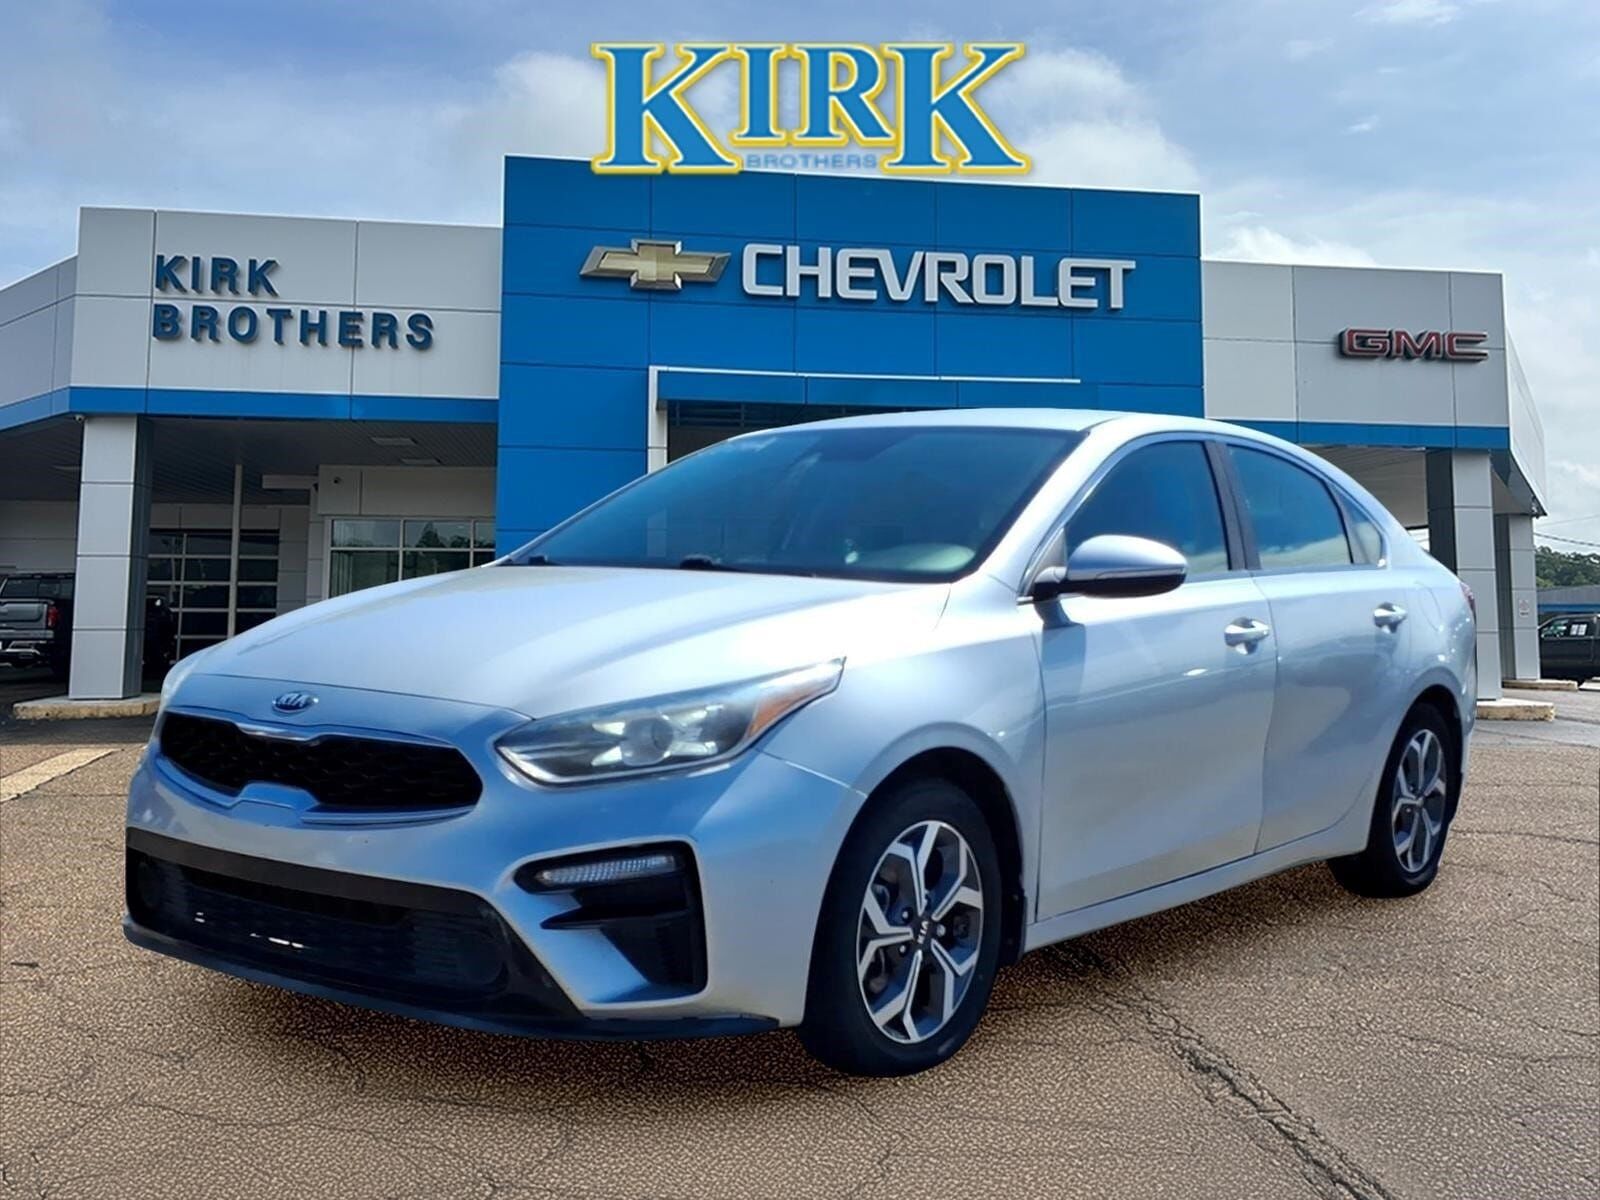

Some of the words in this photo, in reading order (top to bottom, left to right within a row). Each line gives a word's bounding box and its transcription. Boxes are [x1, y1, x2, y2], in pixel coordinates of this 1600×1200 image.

[155, 254, 280, 296] KIRK
[741, 242, 1137, 310] CHEVROLET
[152, 303, 434, 351] BROTHERS
[1338, 327, 1489, 362] GMC
